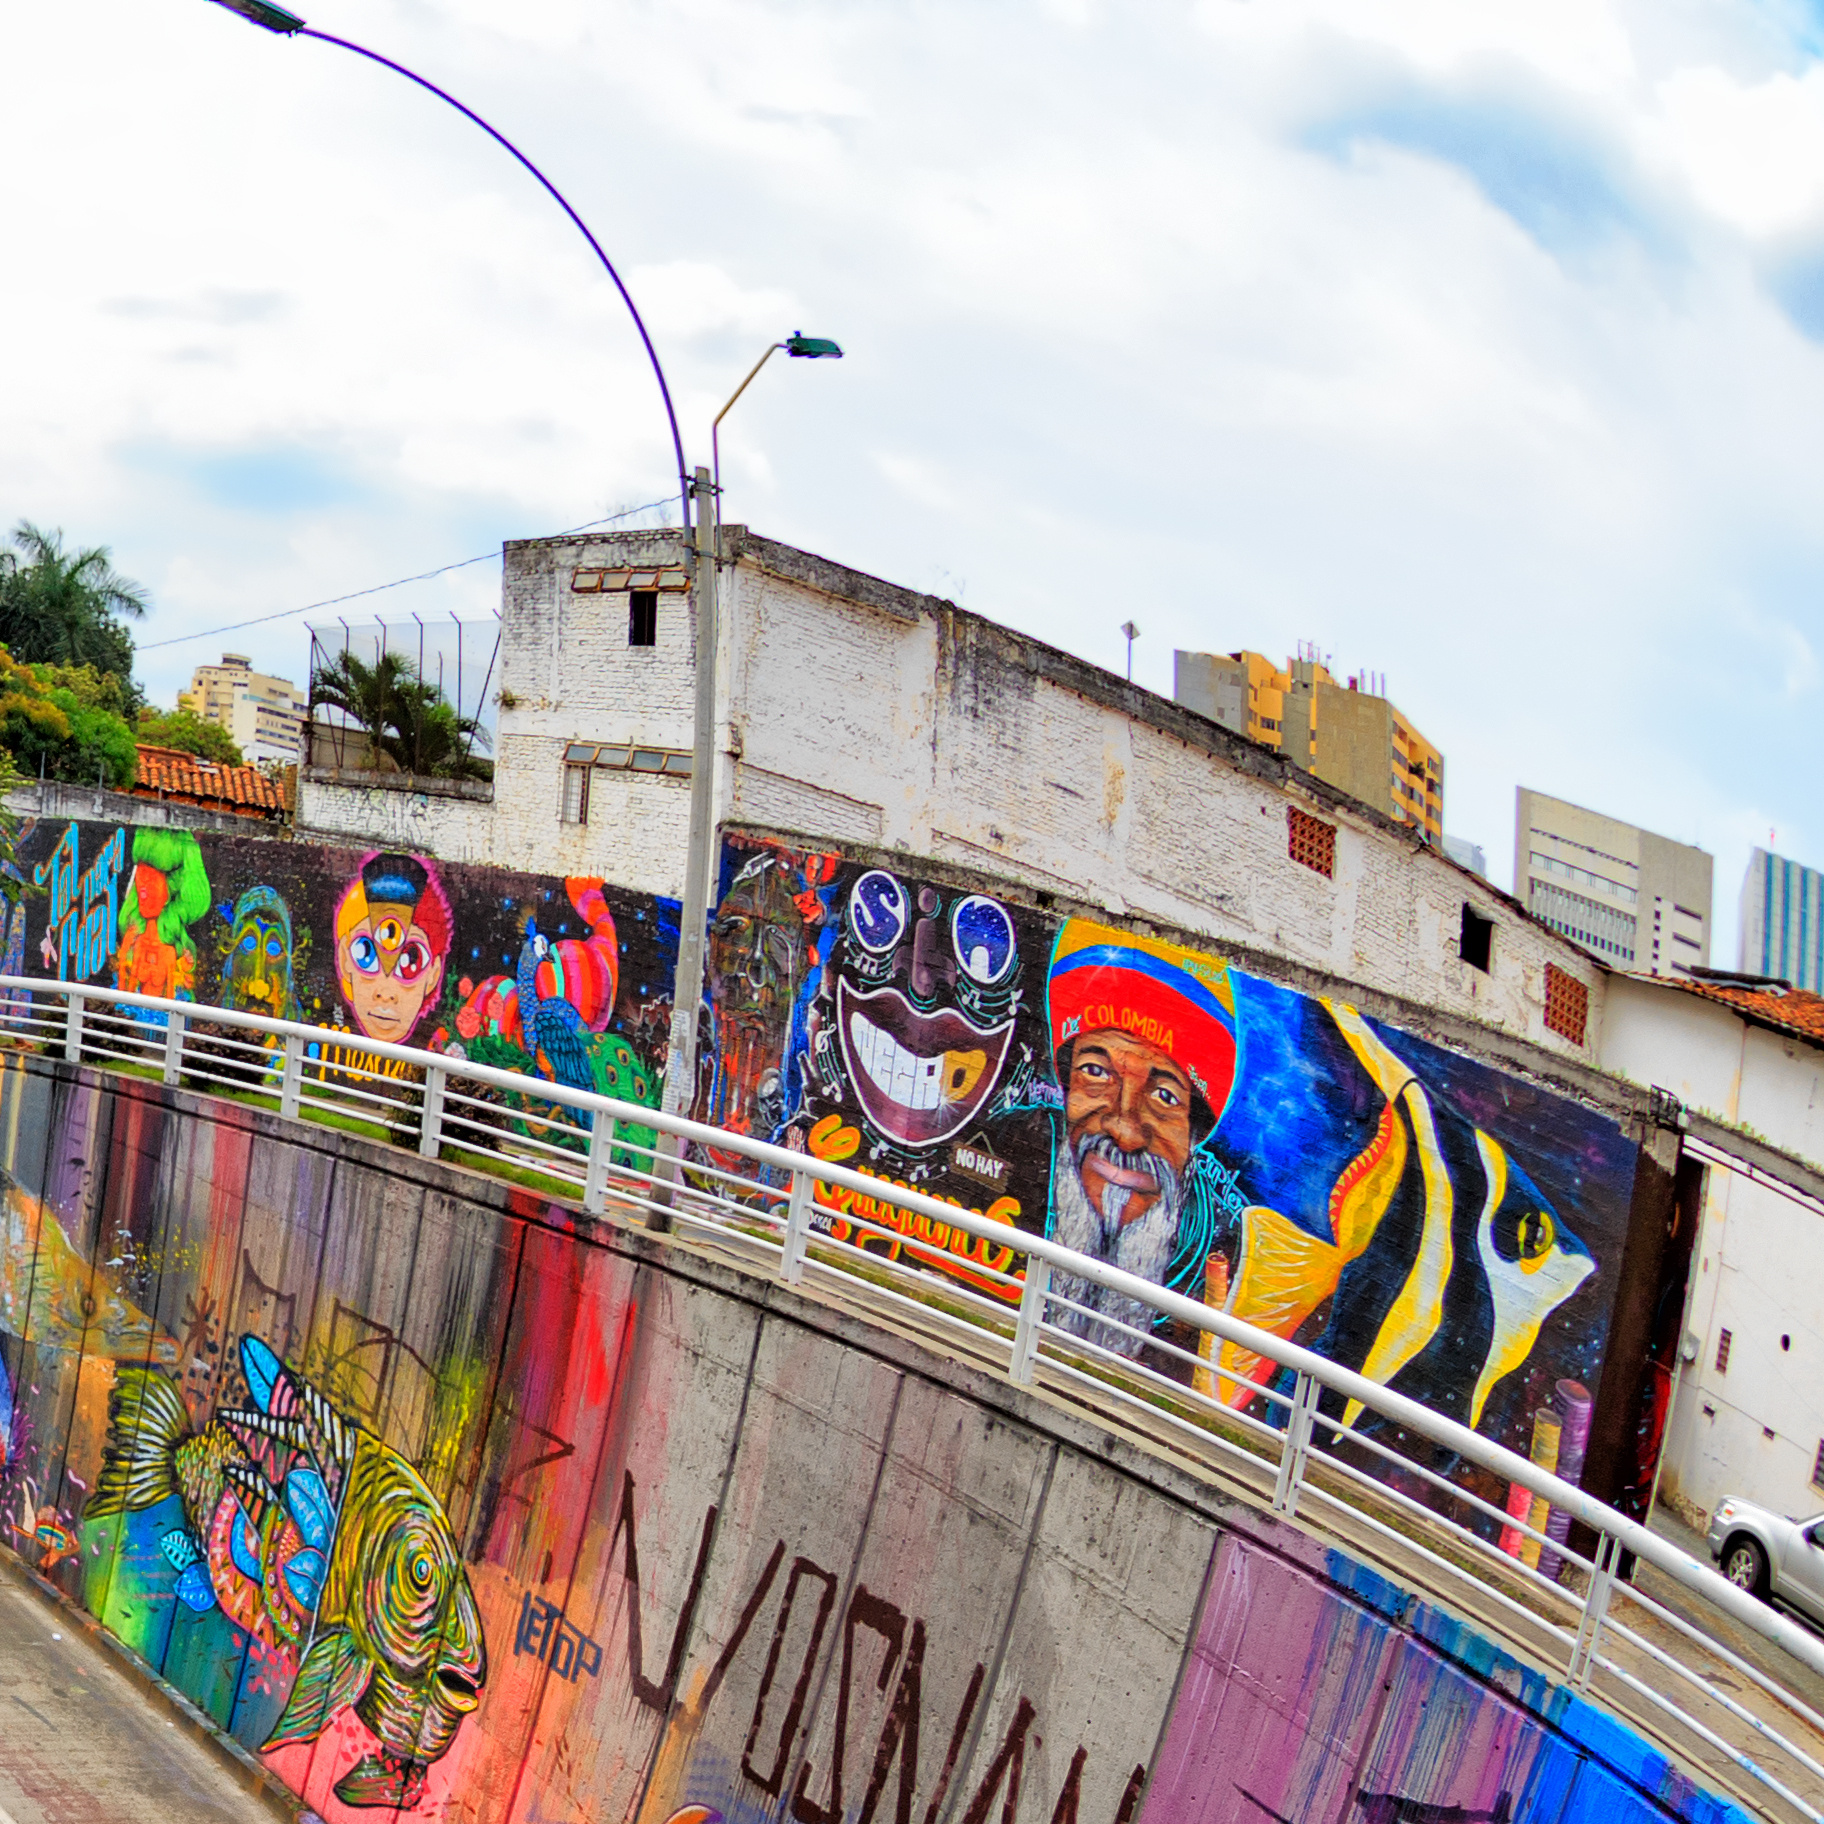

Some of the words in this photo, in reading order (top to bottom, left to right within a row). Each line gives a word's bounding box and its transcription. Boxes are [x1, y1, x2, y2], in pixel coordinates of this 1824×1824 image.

[1084, 1004, 1174, 1053] COLOMBIA
[955, 1148, 975, 1169] NO
[976, 1154, 1005, 1180] HAY
